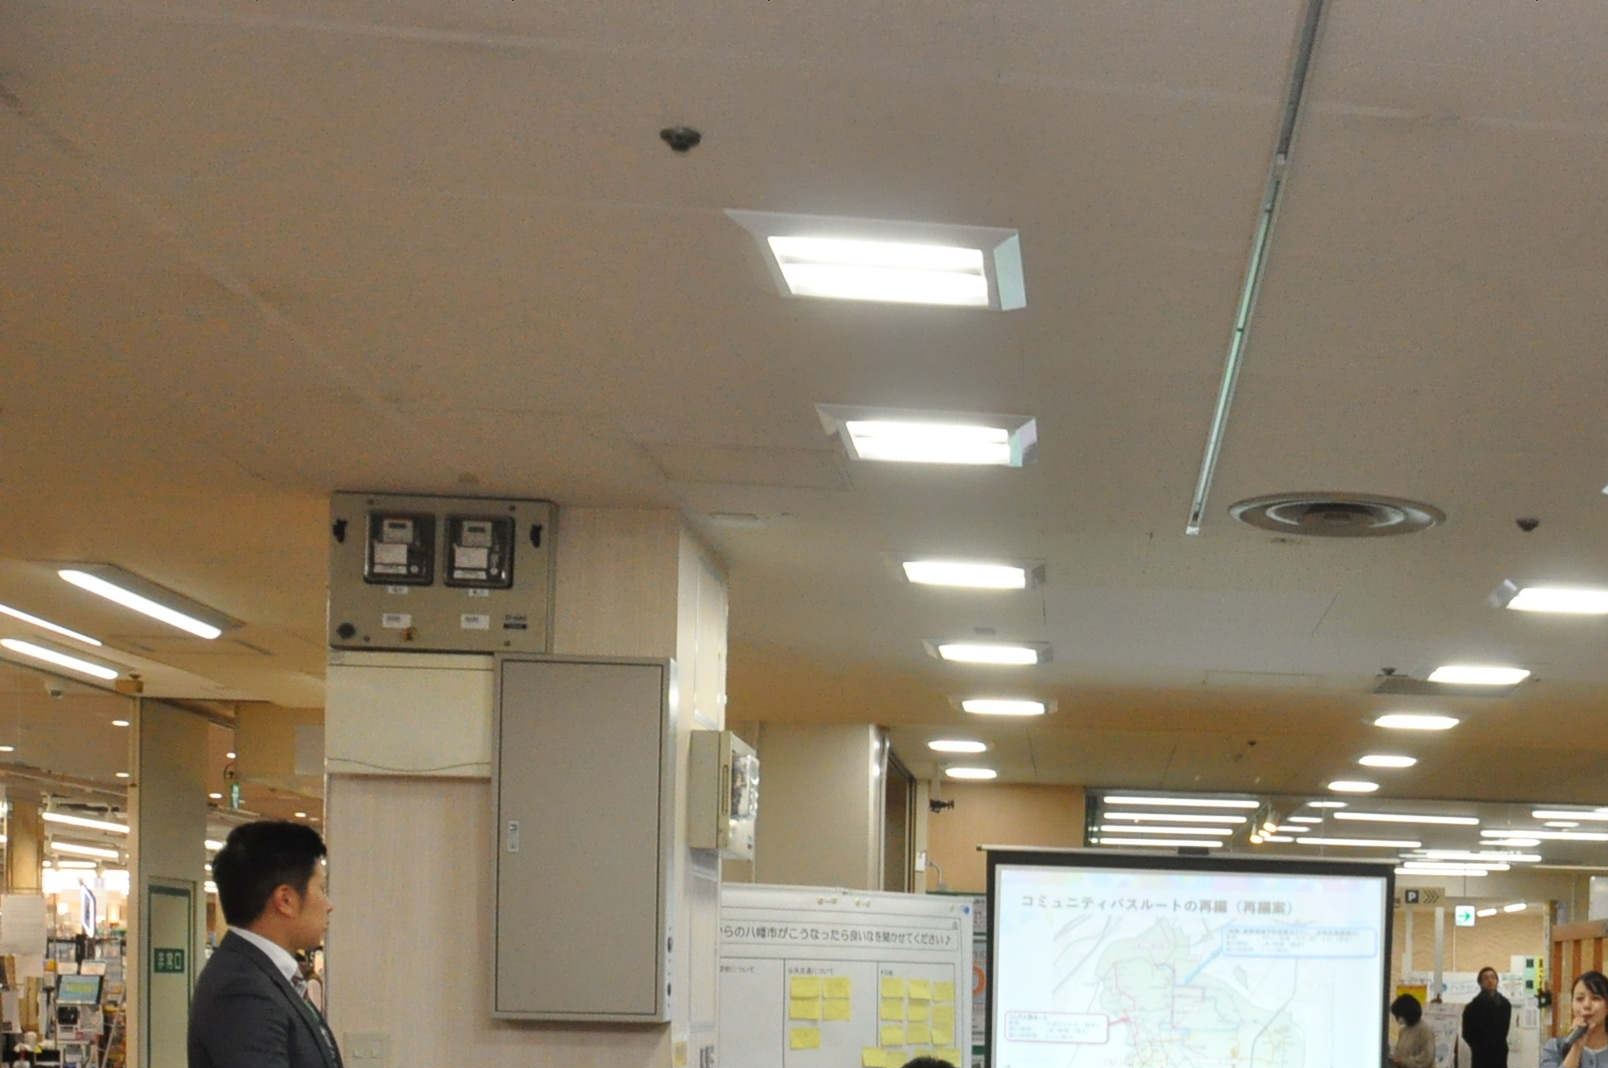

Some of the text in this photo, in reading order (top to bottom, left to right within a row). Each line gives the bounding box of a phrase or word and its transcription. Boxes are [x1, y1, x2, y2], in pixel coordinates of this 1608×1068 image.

[1406, 890, 1417, 903] P
[720, 924, 945, 946] らの八幡市がこうなったら良いなを聞かせてください
